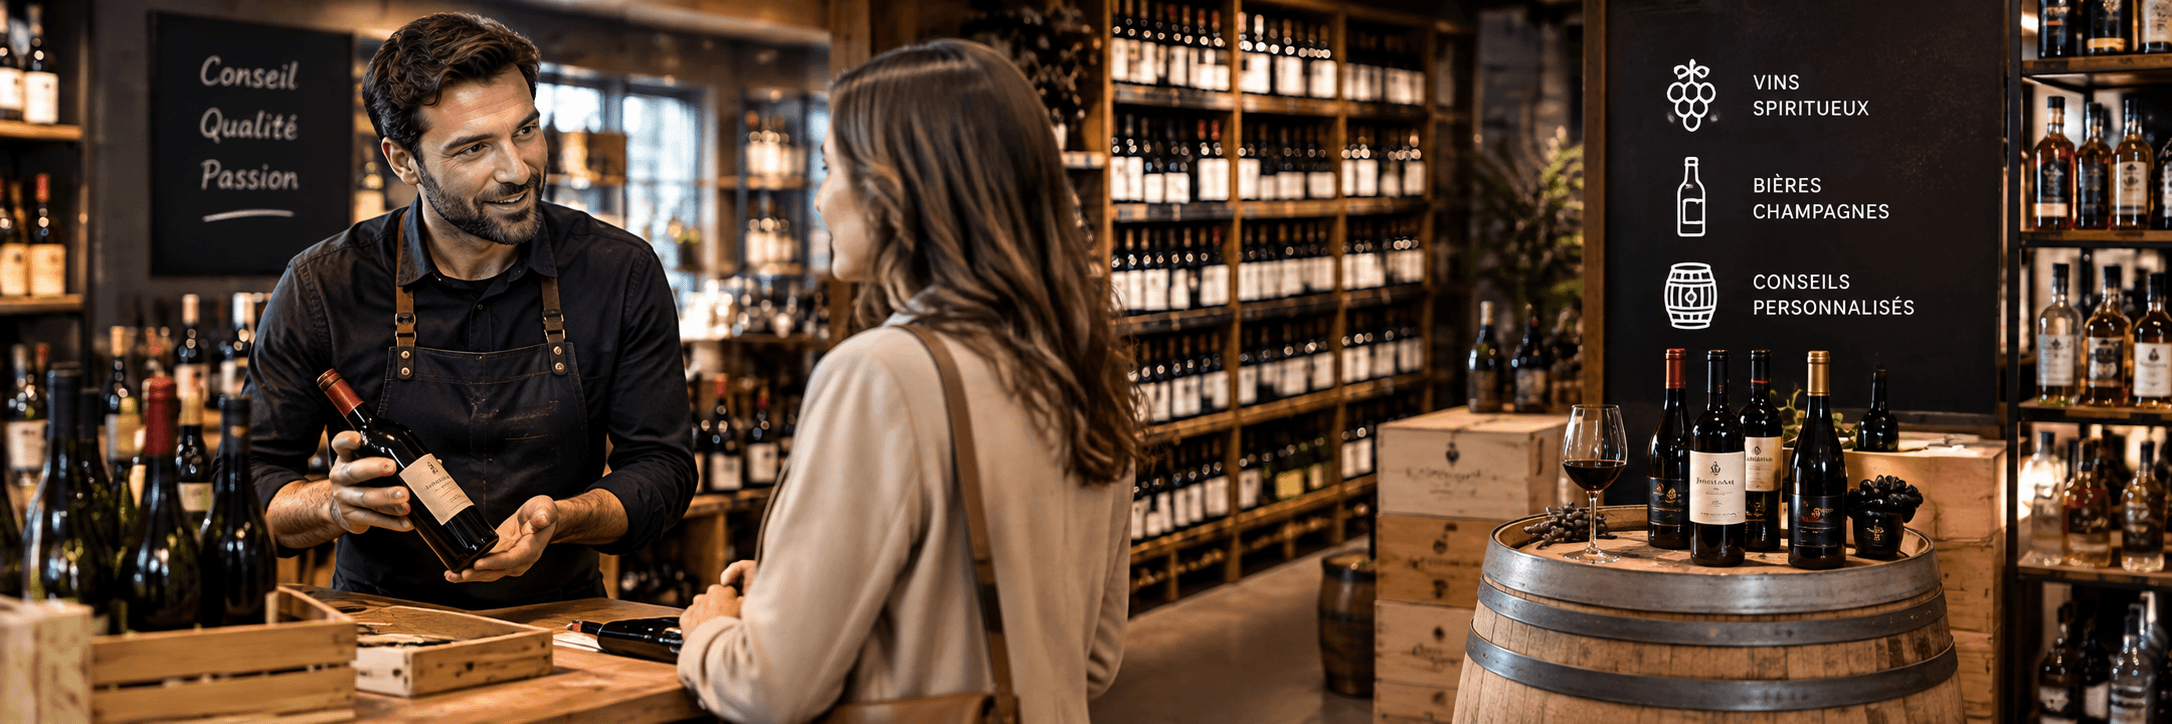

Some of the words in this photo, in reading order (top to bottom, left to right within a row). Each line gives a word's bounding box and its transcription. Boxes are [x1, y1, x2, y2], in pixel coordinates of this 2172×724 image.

[200, 55, 298, 90] Conseil
[1753, 74, 1800, 91] VINS
[1753, 100, 1869, 117] SPIRITUEUX
[200, 108, 298, 142] Qualité
[201, 159, 298, 190] Passion
[1753, 173, 1822, 194] BIÈRES
[1753, 203, 1890, 220] CHAMPAGNES
[1753, 273, 1850, 290] CONSEILS
[1753, 295, 1915, 316] PERSONNALISÉS
